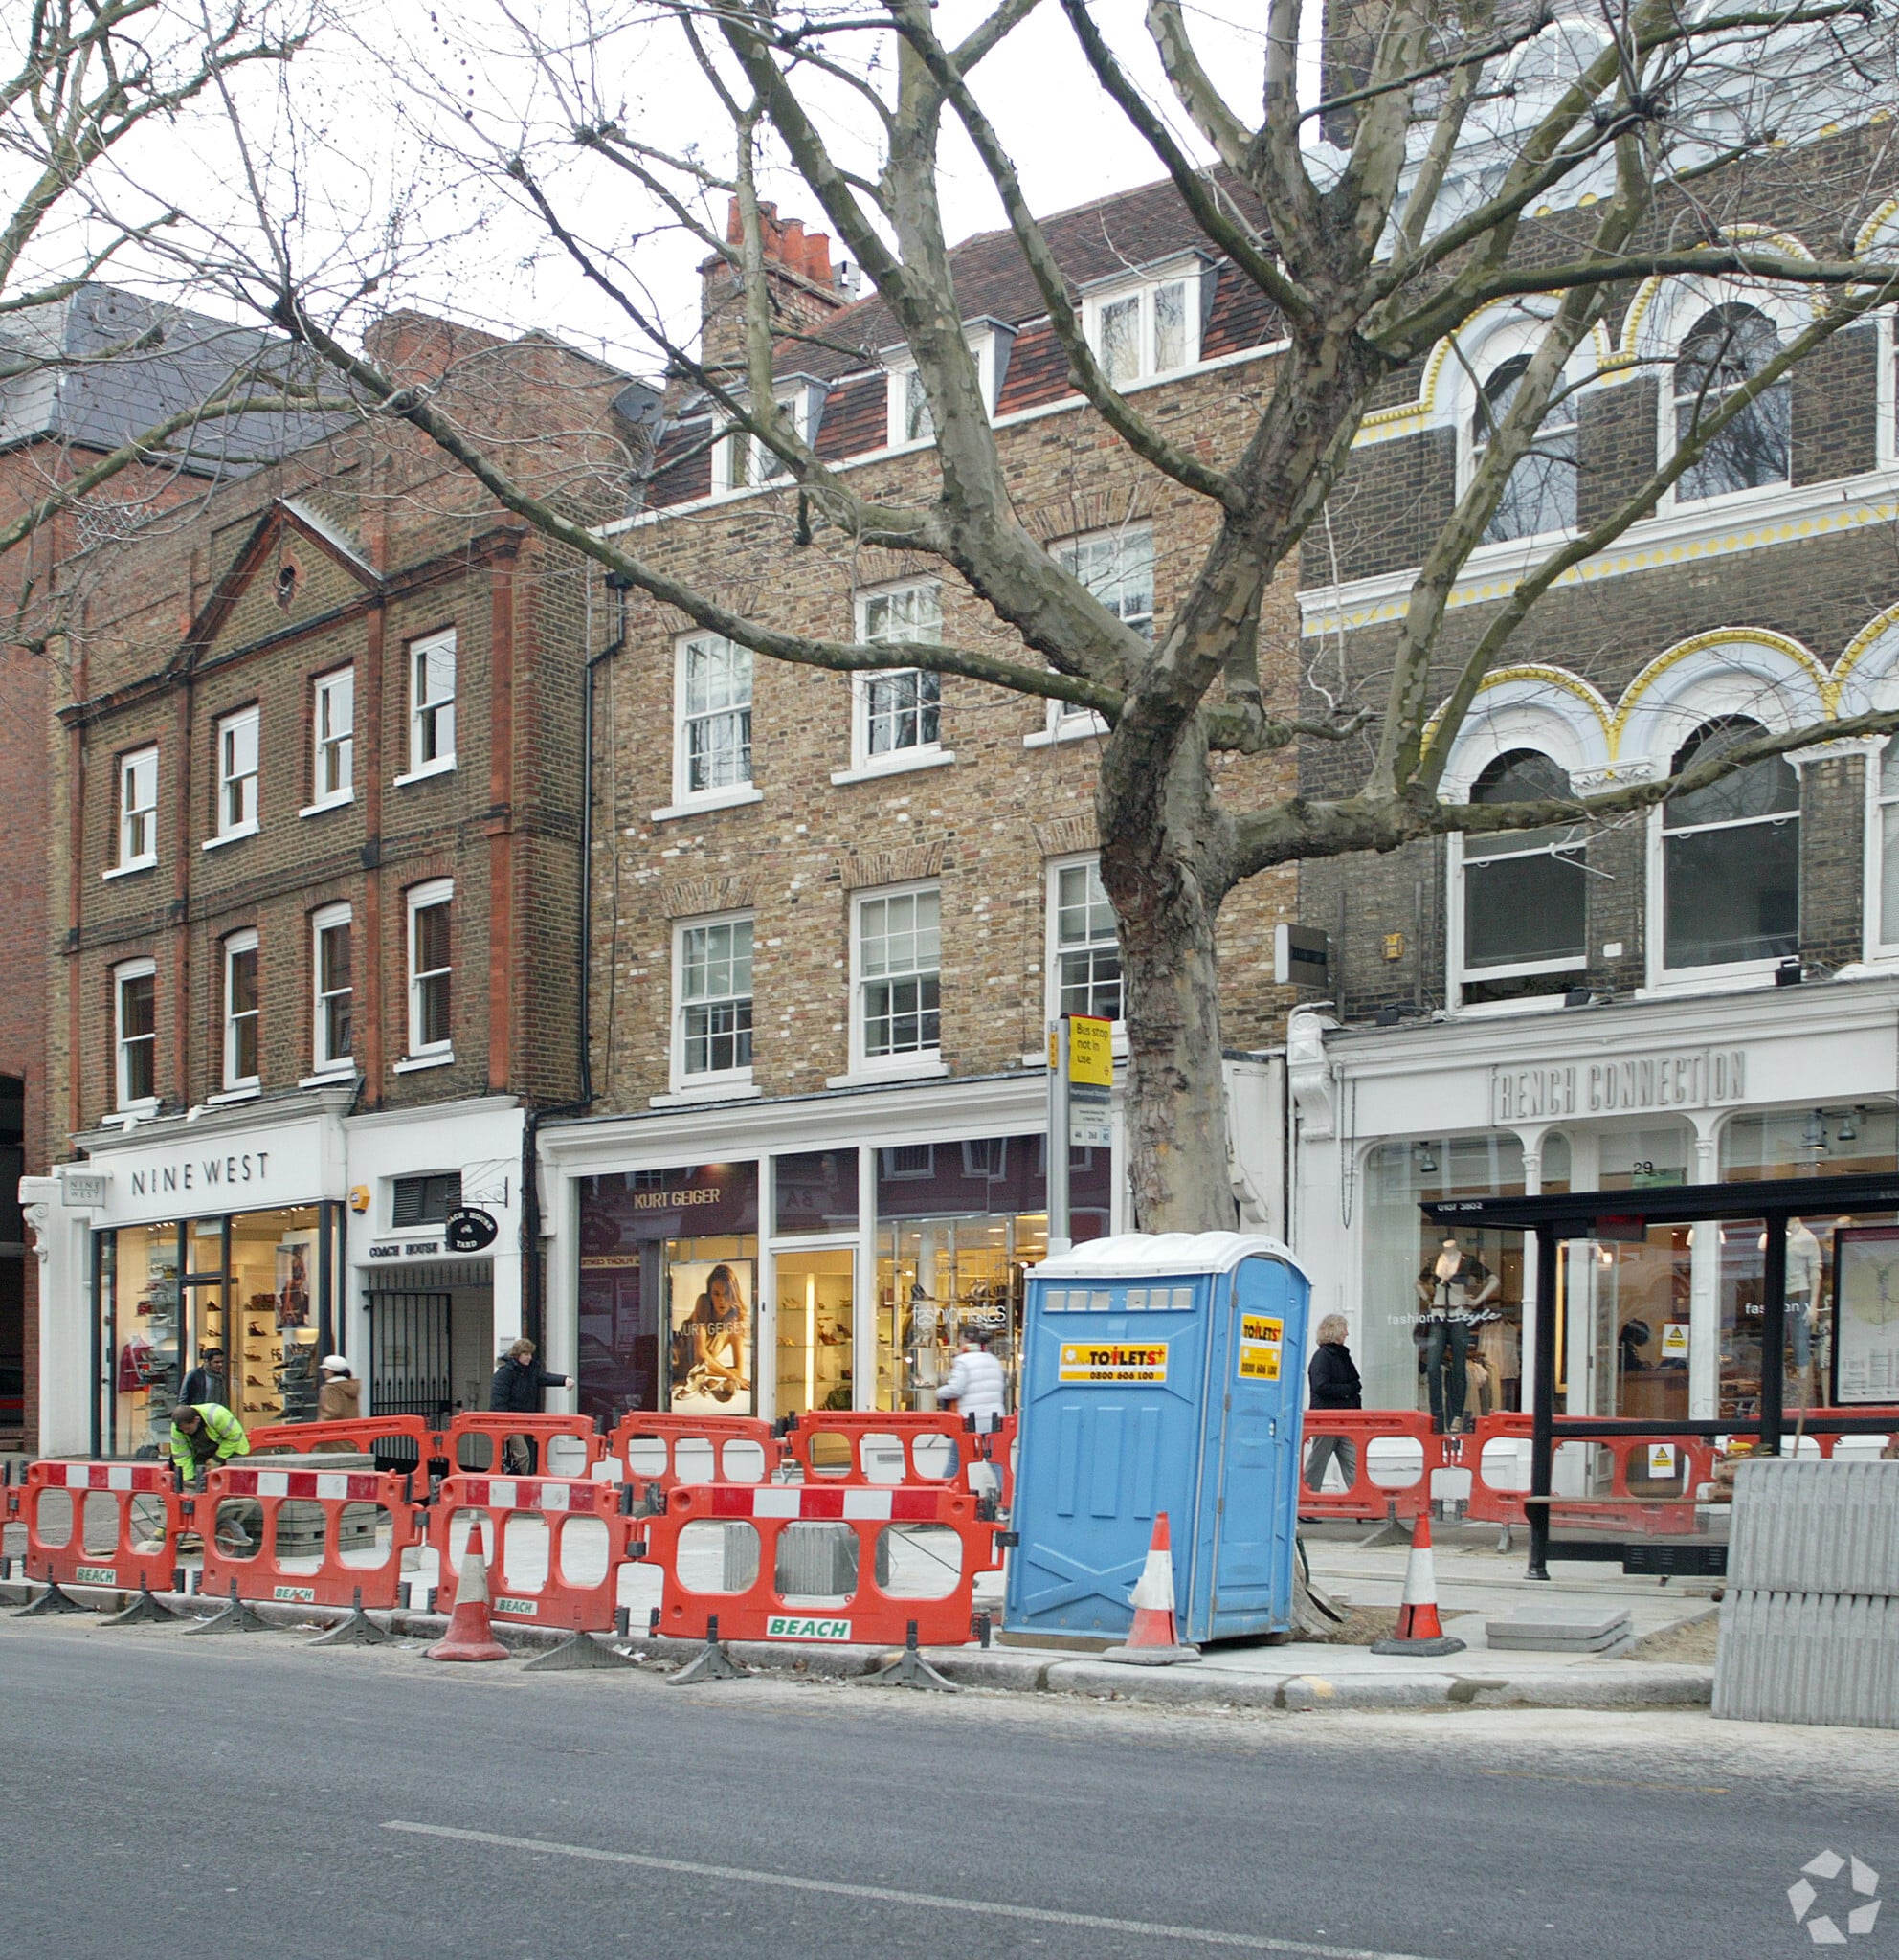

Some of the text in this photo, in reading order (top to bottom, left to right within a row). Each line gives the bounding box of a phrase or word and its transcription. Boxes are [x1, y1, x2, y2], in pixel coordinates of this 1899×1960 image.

[1077, 1022, 1109, 1041] Bus stop
[1077, 1039, 1100, 1052] not in
[1077, 1055, 1092, 1065] use
[1588, 1047, 1745, 1111] CONNECTION
[131, 1151, 269, 1196] NINE WEST
[1632, 1160, 1654, 1175] 29
[70, 1180, 101, 1190] NINE
[70, 1190, 100, 1198] WEST
[634, 1188, 721, 1210] KURT GEIGER
[369, 1245, 400, 1258] COACH
[406, 1241, 439, 1256] HOUSE
[1387, 1312, 1435, 1325] fashion
[674, 1323, 705, 1338] KURT
[1089, 1371, 1154, 1380] 0800 606 100
[77, 1568, 116, 1583] BEACH
[275, 1587, 314, 1601] BEACH
[498, 1599, 533, 1614] BEACH
[769, 1618, 849, 1637] BEACH
